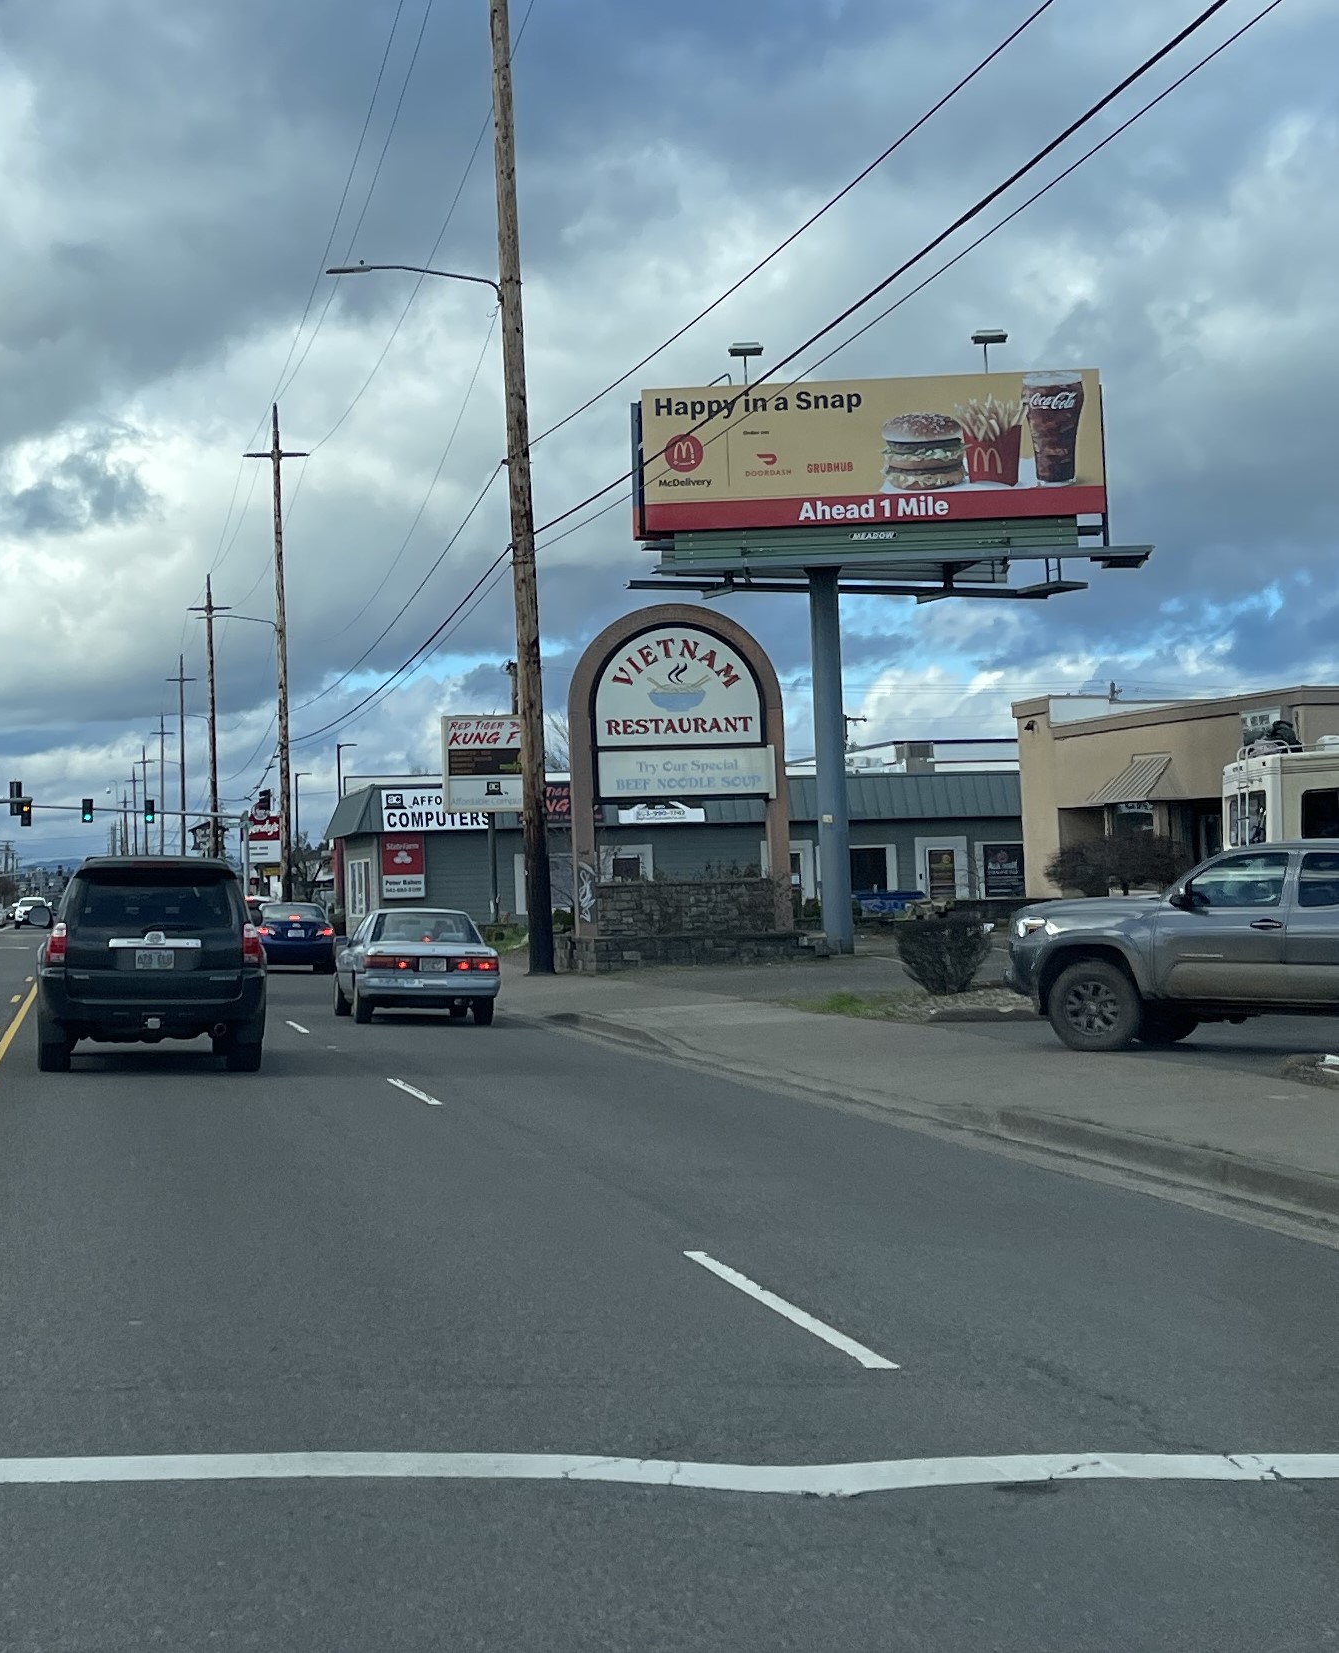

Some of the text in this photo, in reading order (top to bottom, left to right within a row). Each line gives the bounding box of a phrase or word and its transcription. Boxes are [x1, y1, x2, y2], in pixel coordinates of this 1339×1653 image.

[654, 390, 862, 420] Happy in a Snap
[745, 462, 854, 477] DOORDASH GRUBHUB
[659, 477, 712, 488] McDelivery
[798, 495, 949, 521] Ahead 1 Mile
[850, 531, 896, 541] MEADOW
[612, 638, 742, 689] VIETNAM
[449, 720, 504, 731] RED TIGER
[605, 716, 753, 735] RESTAURANT
[449, 731, 521, 746] KUNG F
[636, 759, 739, 774] Try Our Special
[616, 775, 761, 790] BEEF NOODLE SOUP
[546, 786, 570, 797] TIGE
[412, 795, 443, 806] AFFO
[248, 819, 279, 835] endy's
[387, 812, 490, 828] COMPUTERS
